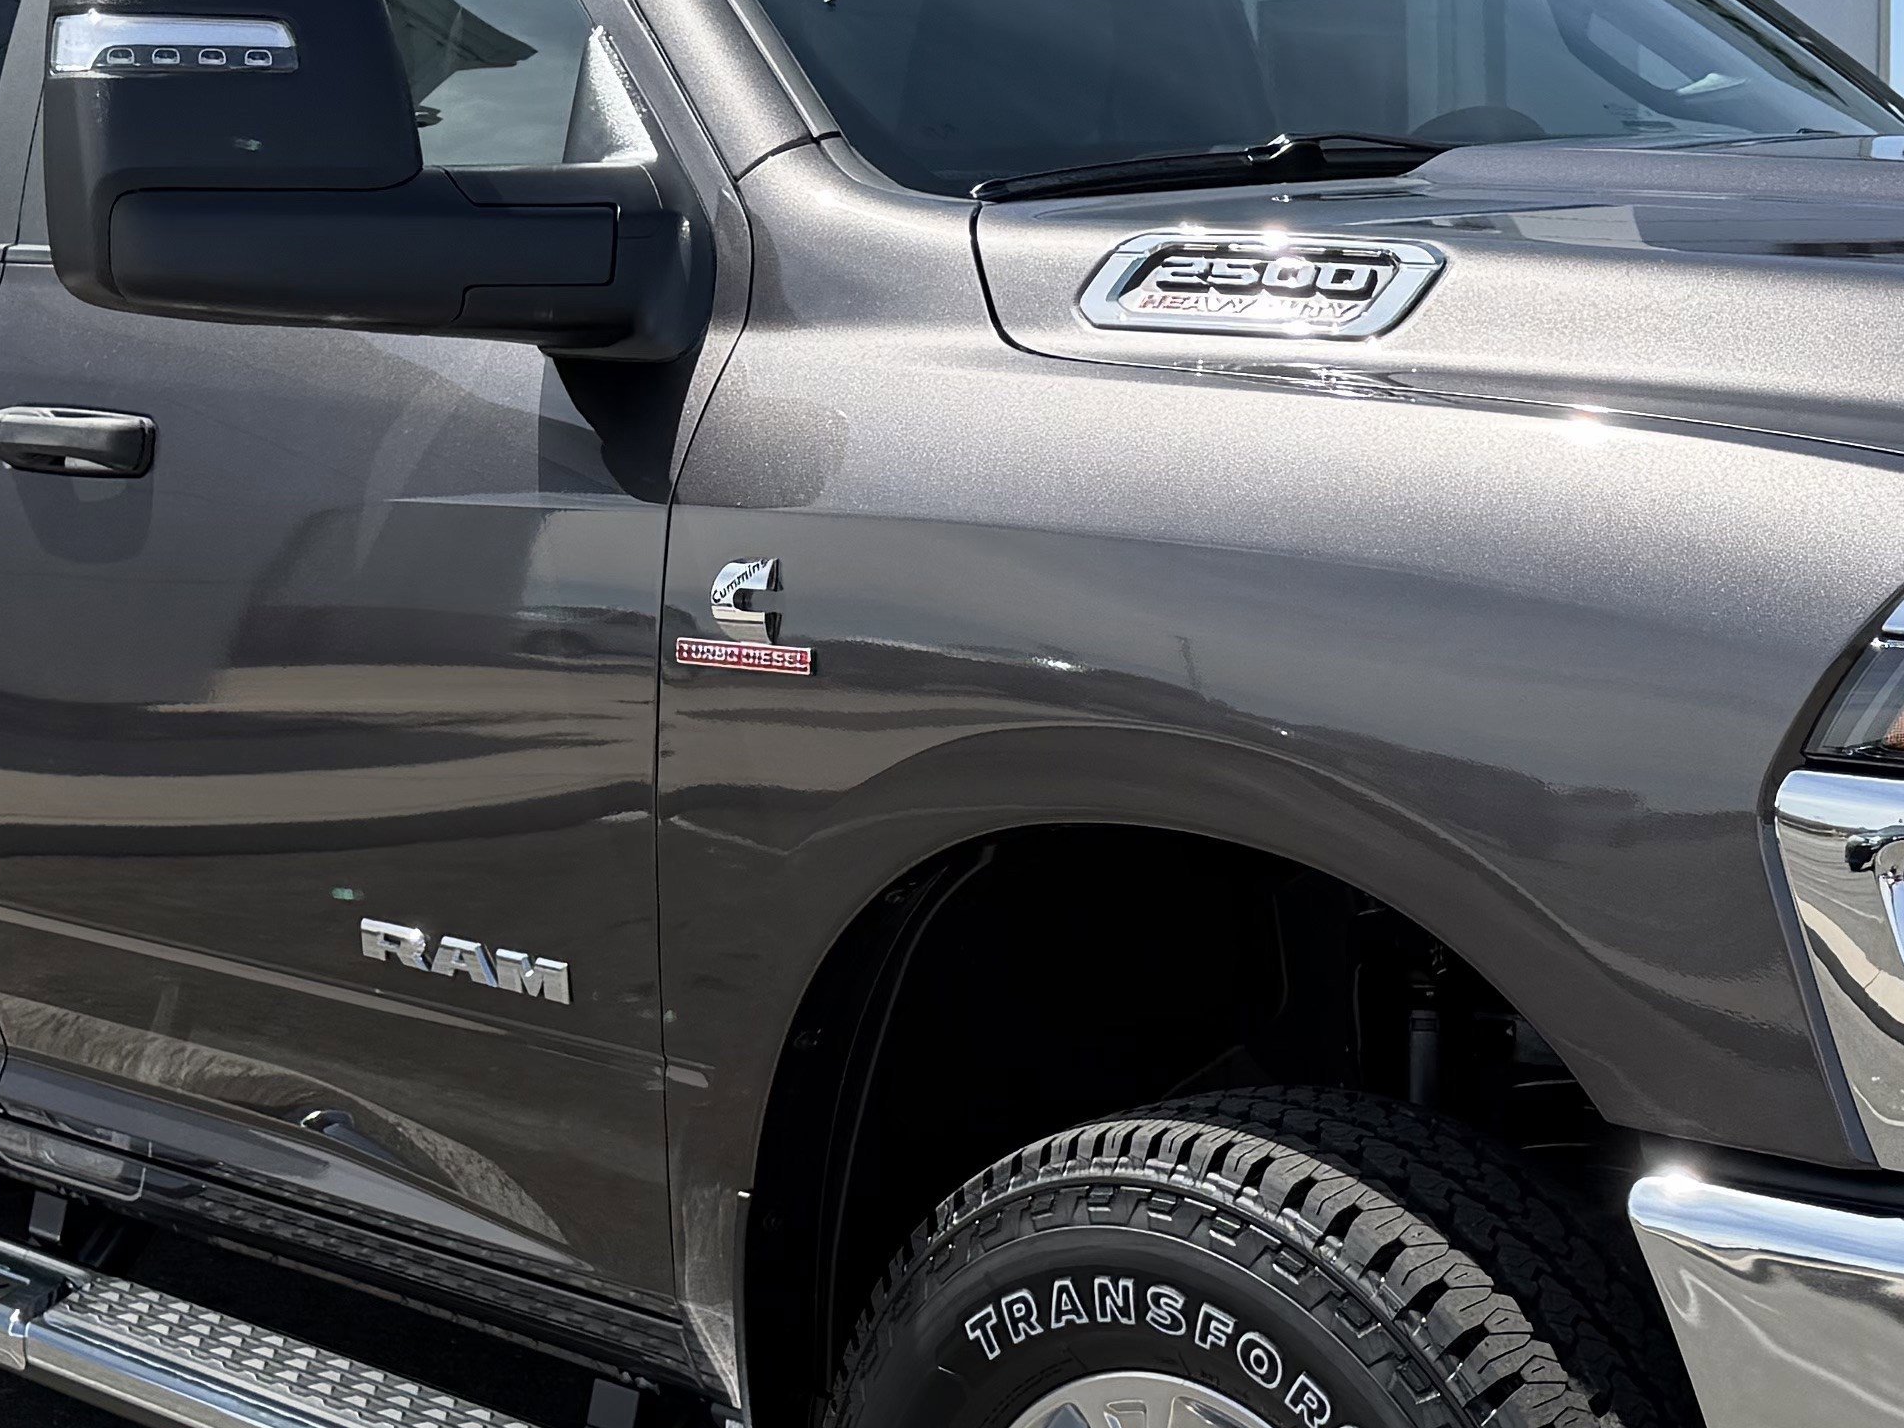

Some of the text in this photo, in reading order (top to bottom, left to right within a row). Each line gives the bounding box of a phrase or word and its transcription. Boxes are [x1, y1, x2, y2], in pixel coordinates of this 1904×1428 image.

[1156, 256, 1375, 298] 2500
[711, 558, 769, 604] Cummins
[360, 917, 571, 1005] RAM
